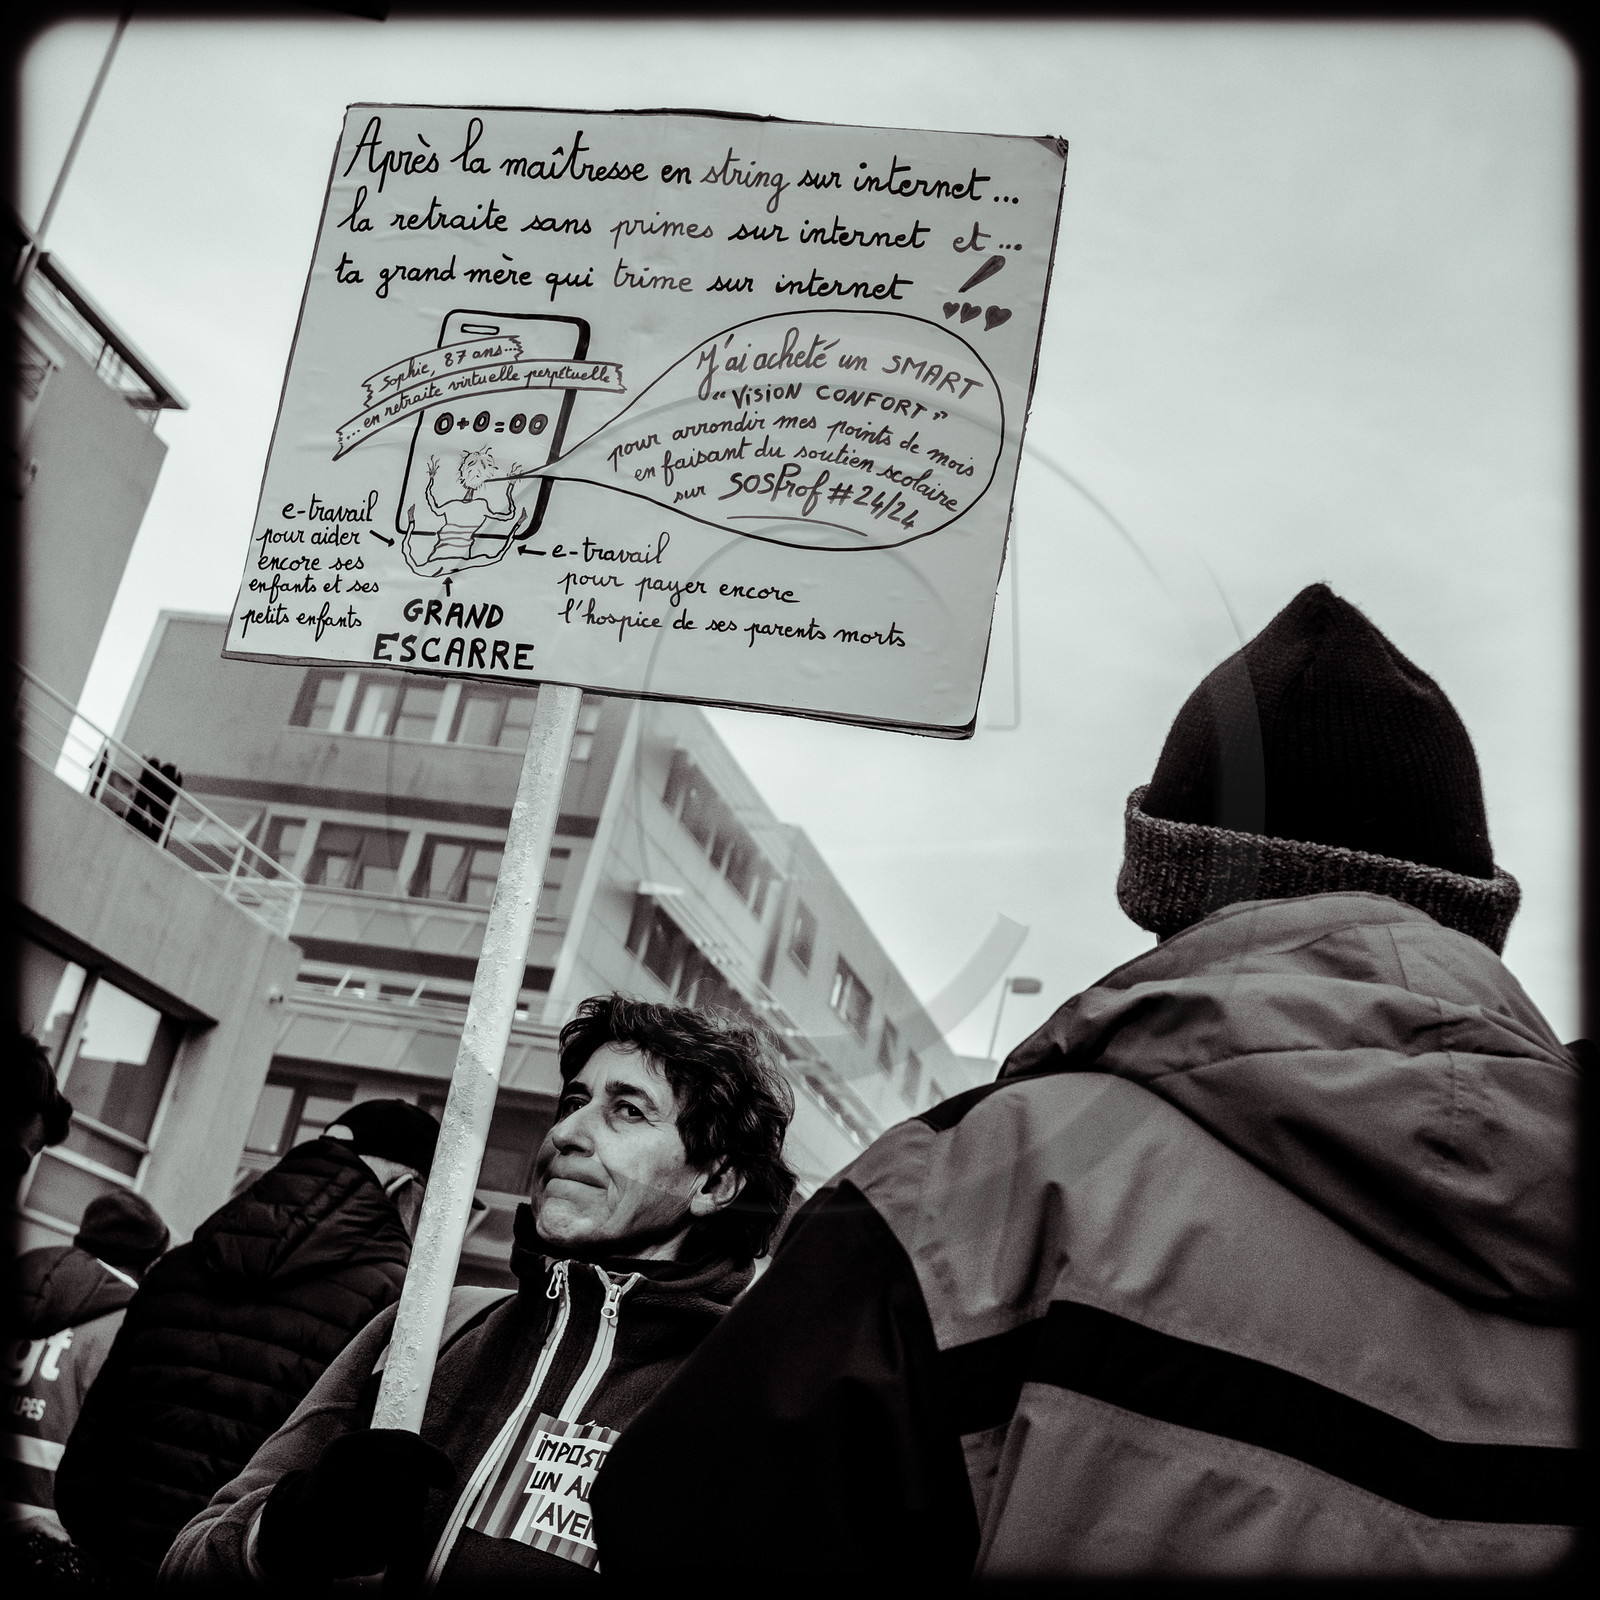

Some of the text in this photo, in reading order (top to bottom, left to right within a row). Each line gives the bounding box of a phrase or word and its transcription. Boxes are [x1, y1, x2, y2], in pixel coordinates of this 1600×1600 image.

[344, 116, 440, 192] Après
[451, 118, 491, 174] la
[500, 130, 648, 182] maîtresse
[661, 165, 692, 184] en
[700, 148, 790, 212] string
[798, 168, 842, 188] sur
[337, 186, 374, 232] la
[390, 196, 508, 232] retraite
[520, 216, 592, 234] sans
[610, 211, 713, 249] primes
[728, 222, 790, 242] sur
[800, 216, 931, 248] internet
[335, 252, 364, 284] ta
[376, 255, 456, 299] grand
[464, 253, 532, 286] mère
[546, 268, 594, 302] qui
[614, 258, 693, 292] trime
[706, 274, 754, 292] sur
[776, 268, 913, 300] internet
[378, 357, 435, 392] Sophie,
[444, 350, 466, 367] 87
[753, 327, 840, 370] acheté
[838, 354, 868, 372] un
[882, 354, 984, 400] SMART
[384, 382, 443, 416] retraite
[448, 366, 520, 391] virtuelle
[524, 366, 610, 388] perpétuelle
[606, 411, 974, 477] pour arrondir mes points de mois
[634, 436, 958, 512] en faisant du soutien scolaire
[282, 490, 378, 522] e-travail
[672, 484, 707, 504] sur
[256, 524, 360, 558] pour aider
[552, 532, 670, 564] e-travail
[258, 555, 365, 571] encore ses
[249, 574, 380, 604] enfants et ses
[557, 572, 800, 607] pour payer encore
[240, 602, 362, 642] petits enfants
[403, 598, 504, 630] GRAND
[558, 598, 906, 648] l'hospice de ses parents morts
[373, 632, 534, 670] ESCARRE
[530, 1470, 563, 1492] UN
